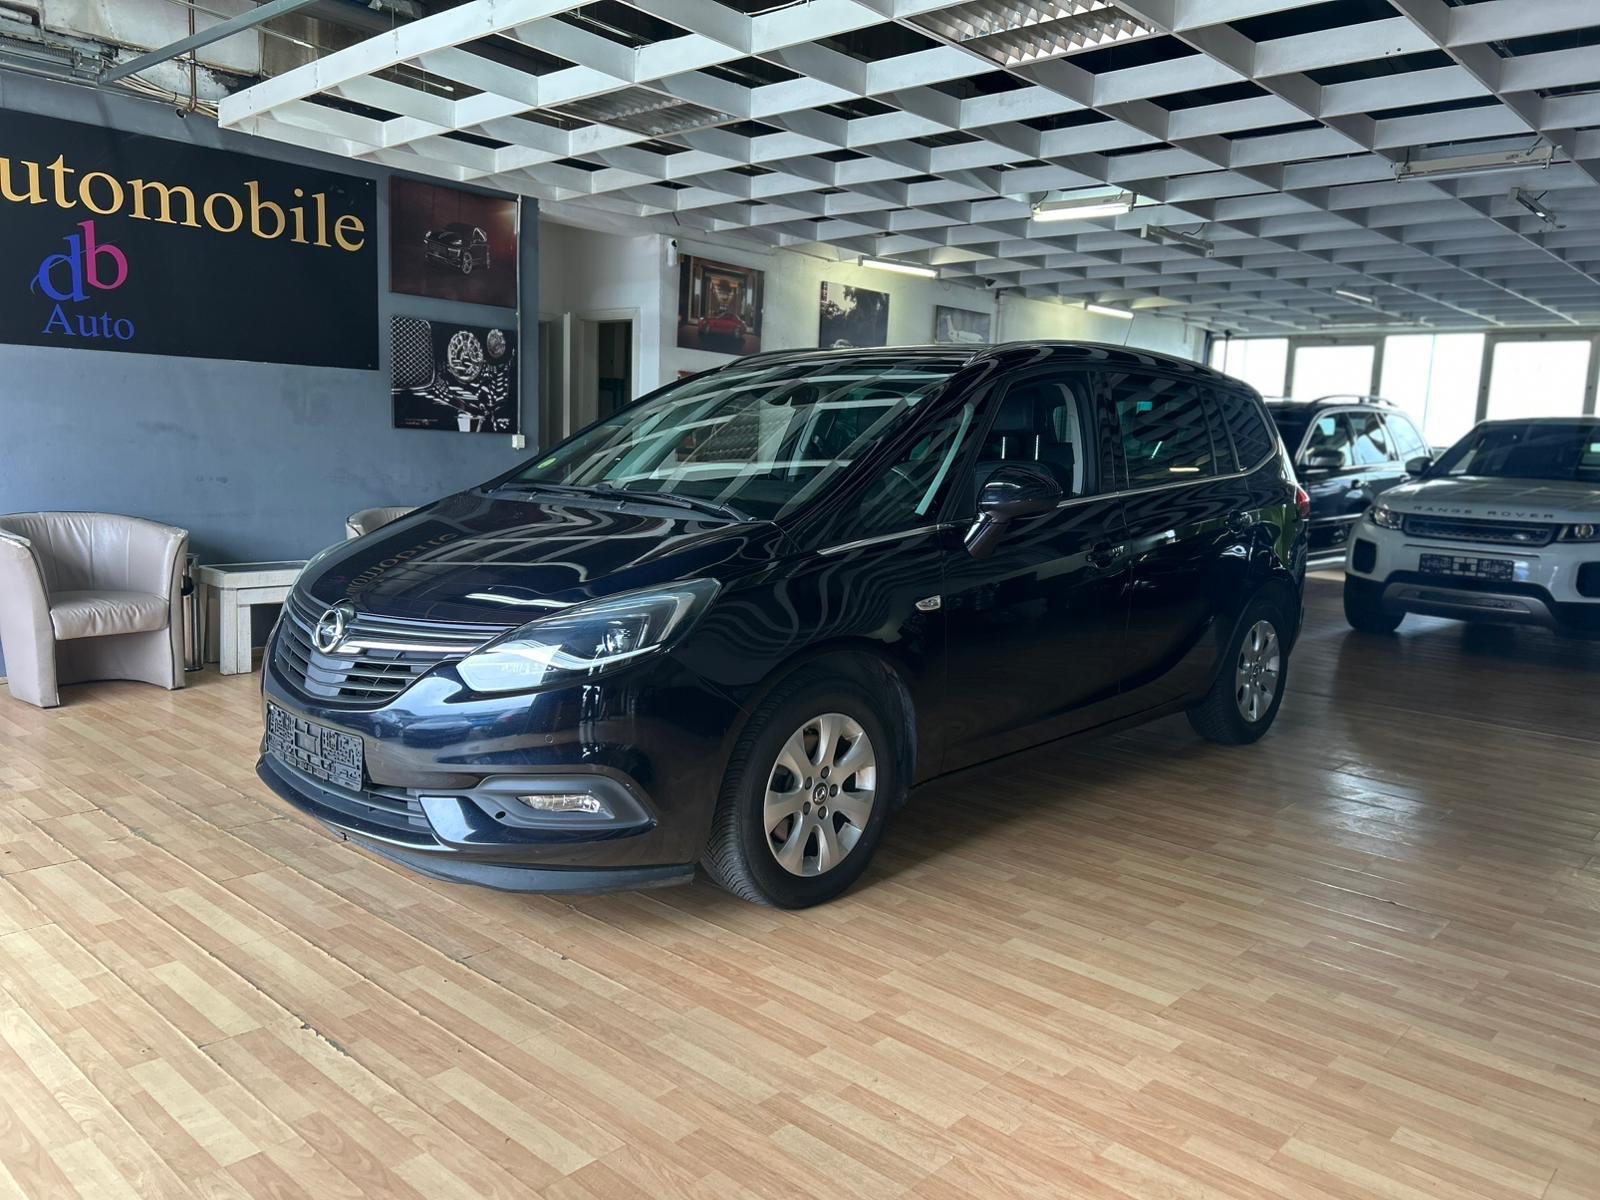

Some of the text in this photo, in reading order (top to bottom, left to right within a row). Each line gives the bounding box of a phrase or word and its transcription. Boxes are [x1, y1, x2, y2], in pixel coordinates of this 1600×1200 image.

[37, 219, 129, 303] db
[41, 303, 136, 340] Auto
[1413, 505, 1555, 519] RANGE ROVER
